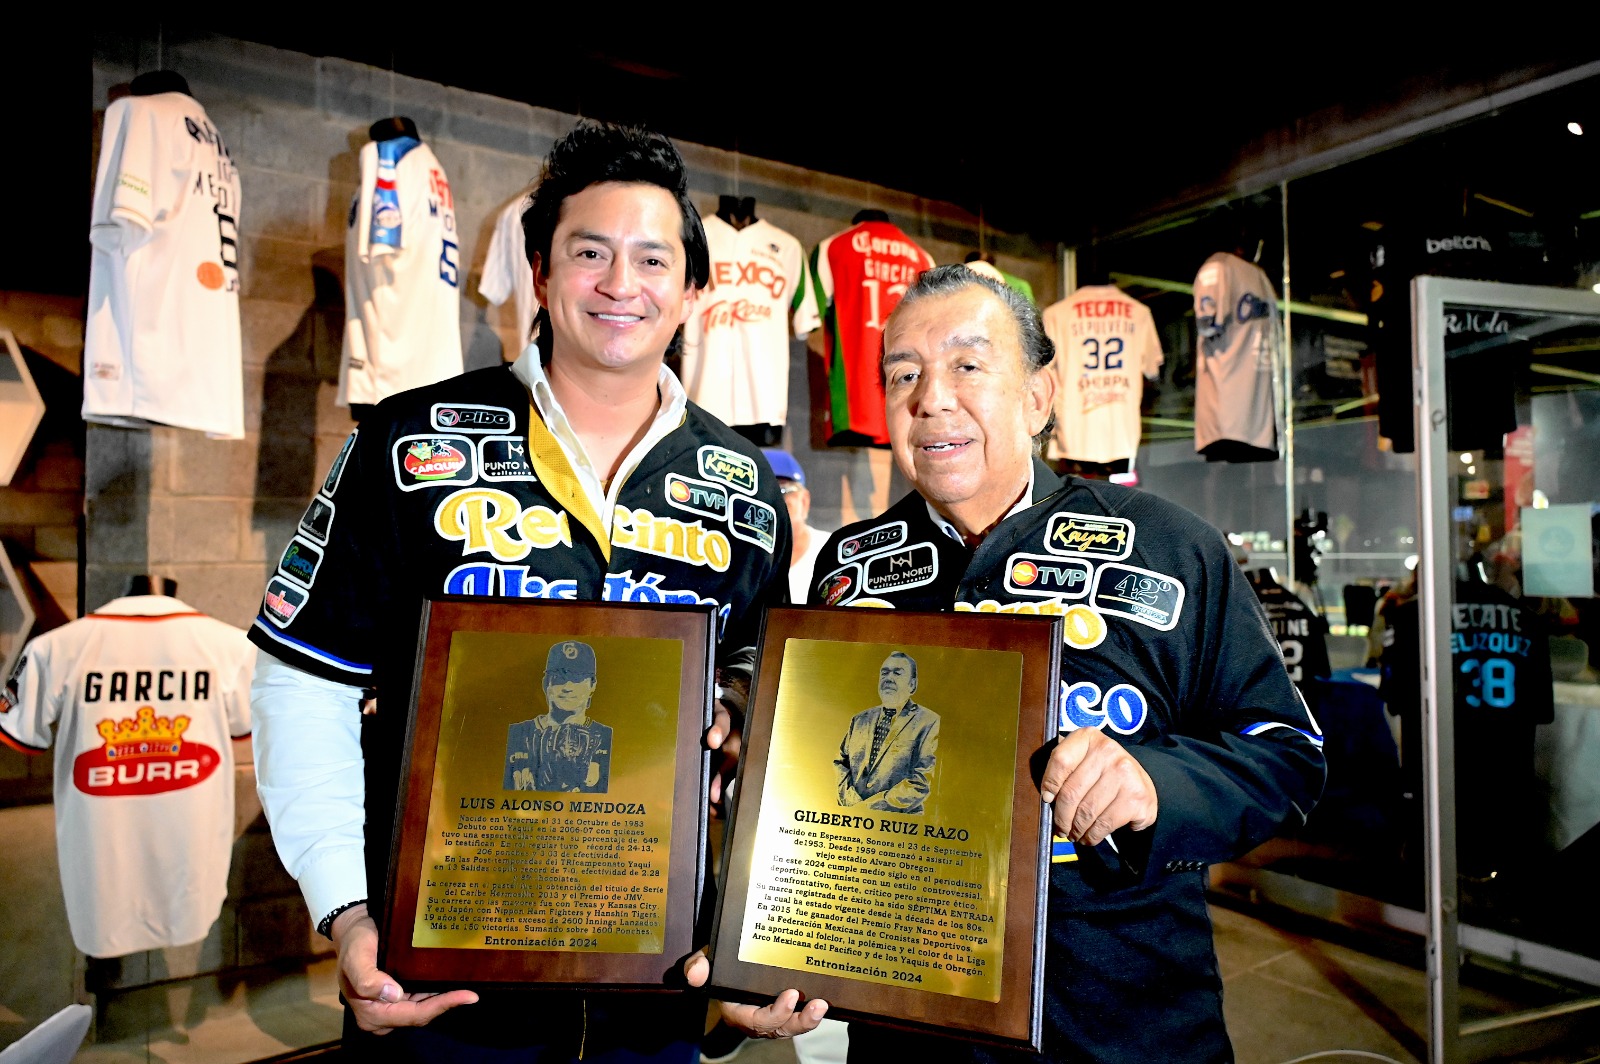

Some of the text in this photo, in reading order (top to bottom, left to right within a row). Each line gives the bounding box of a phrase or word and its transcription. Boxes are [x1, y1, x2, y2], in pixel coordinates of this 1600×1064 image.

[851, 230, 919, 263] Corona
[708, 260, 787, 299] EXICO
[1073, 300, 1134, 319] TECATE
[1083, 337, 1124, 370] 32
[458, 411, 510, 425] Pibo
[484, 461, 520, 471] PUNTO
[690, 488, 726, 510] TVP
[868, 565, 933, 585] PUNTO NORTE
[1037, 566, 1087, 587] TVP
[1452, 602, 1522, 632] ECATE
[84, 670, 210, 703] GARCIA
[1460, 657, 1516, 708] 38
[88, 759, 200, 788] BURR
[459, 797, 646, 815] LUIS ALONSO MENDOZA
[793, 808, 969, 842] GILBERTO RUIZ RAZO
[484, 935, 597, 948] Entronización 2024
[804, 955, 923, 984] Entronización 2024
